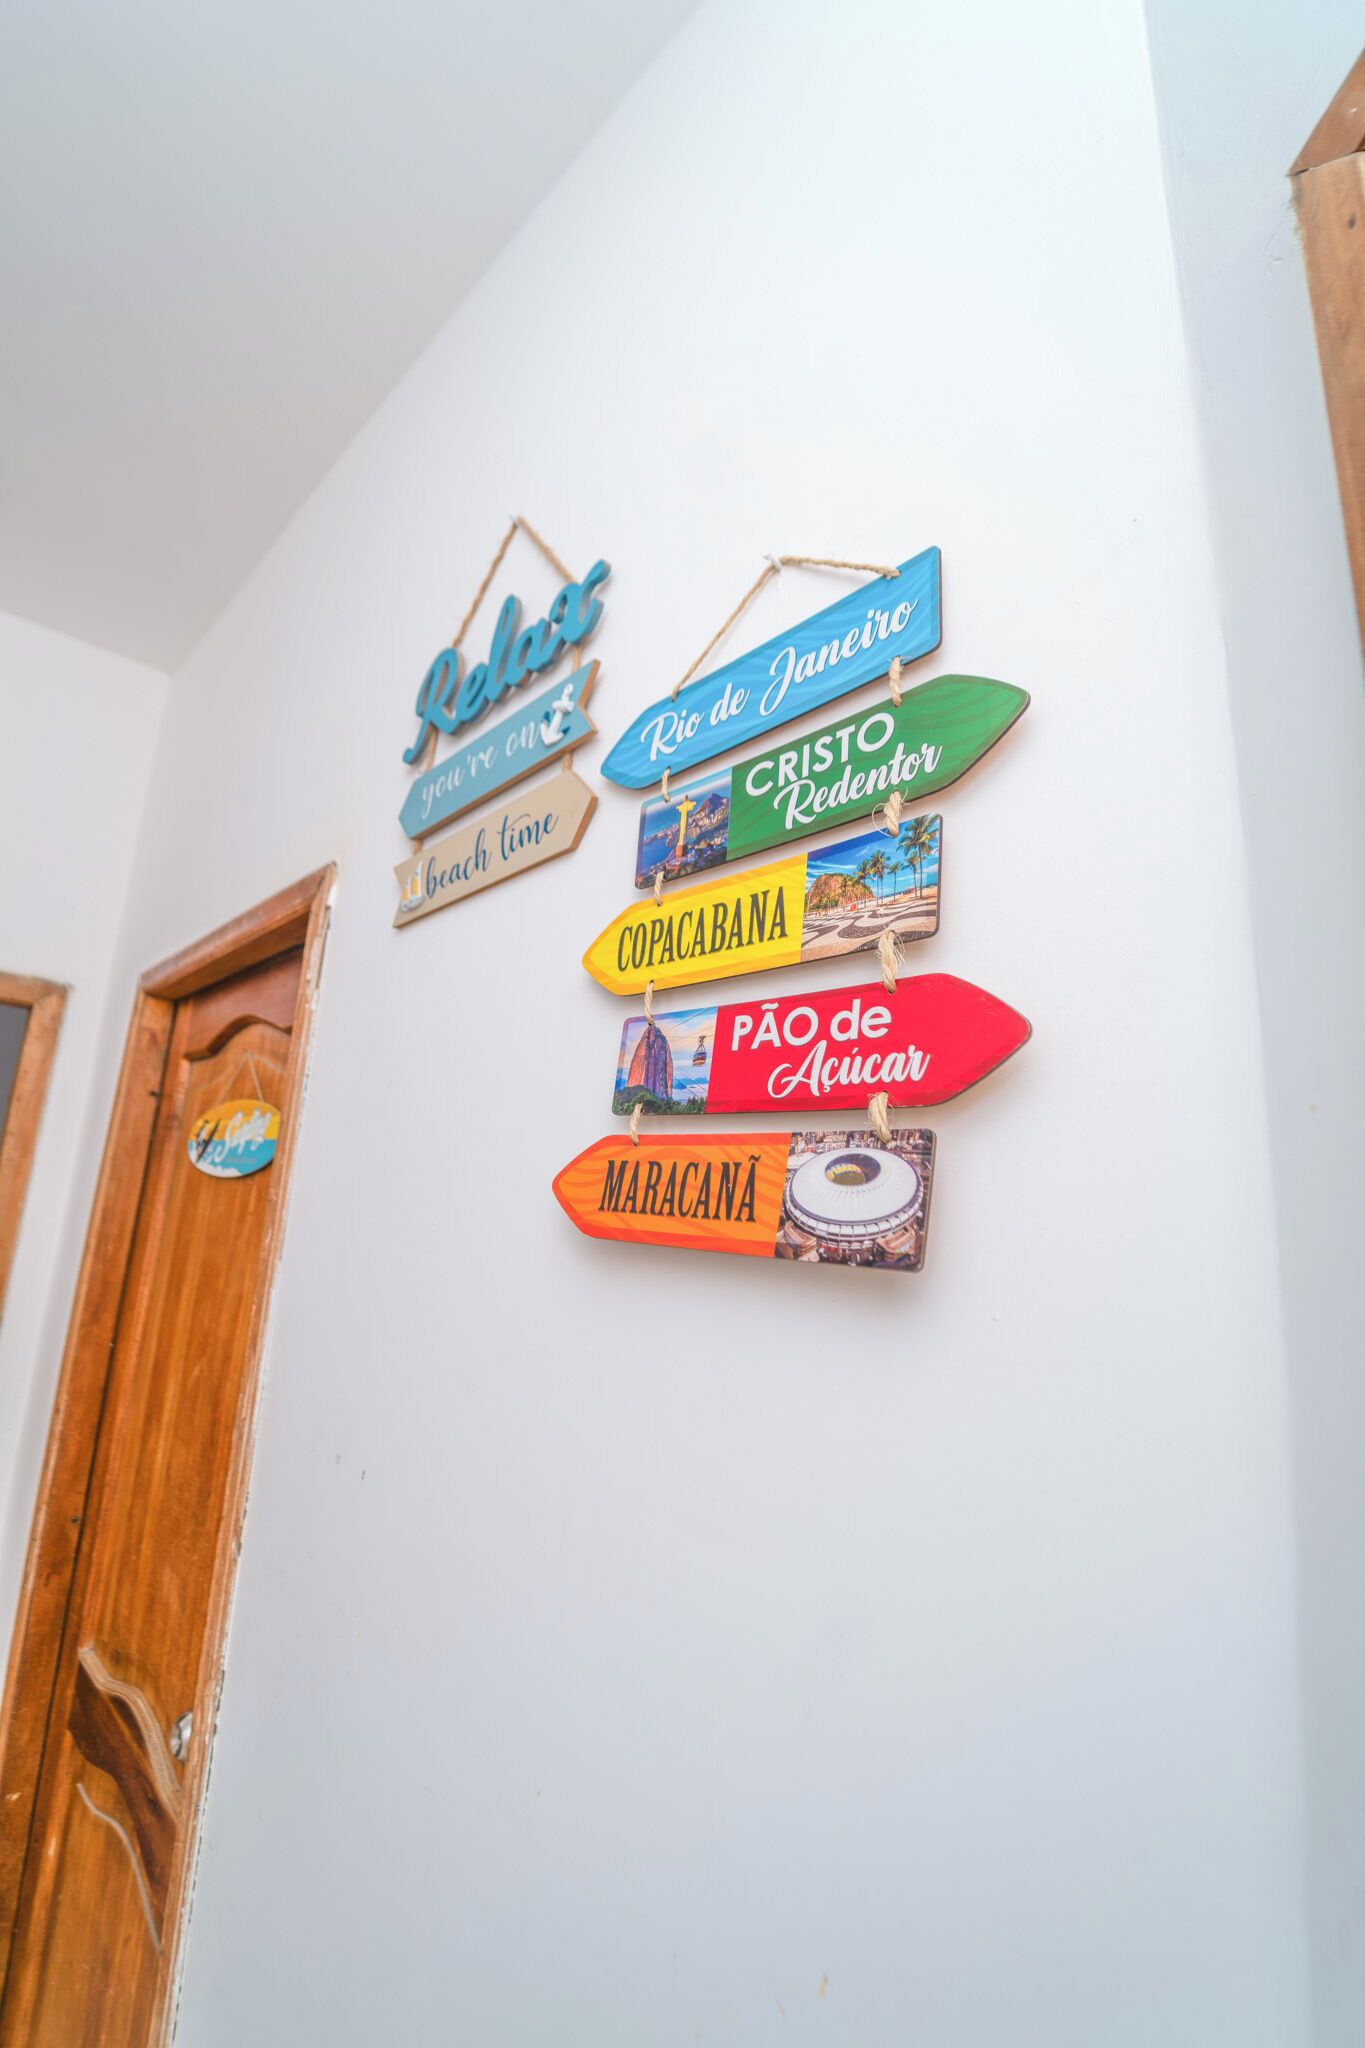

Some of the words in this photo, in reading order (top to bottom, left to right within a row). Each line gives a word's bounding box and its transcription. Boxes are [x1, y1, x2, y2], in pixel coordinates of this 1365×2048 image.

[403, 559, 611, 764] Relax
[641, 708, 705, 762] Rio
[710, 681, 751, 727] de
[760, 599, 918, 716] Janeiro
[421, 749, 498, 819] you're
[505, 719, 542, 758] on
[745, 712, 895, 796] CRISTO
[774, 741, 943, 830] Redentor
[426, 828, 492, 899] beach
[497, 811, 559, 862] time
[617, 886, 788, 972] COPACABANA
[731, 1002, 818, 1051] PÃO
[830, 998, 892, 1041] de
[767, 1039, 931, 1099] Açúcar
[598, 1154, 761, 1222] MARACANÃ
